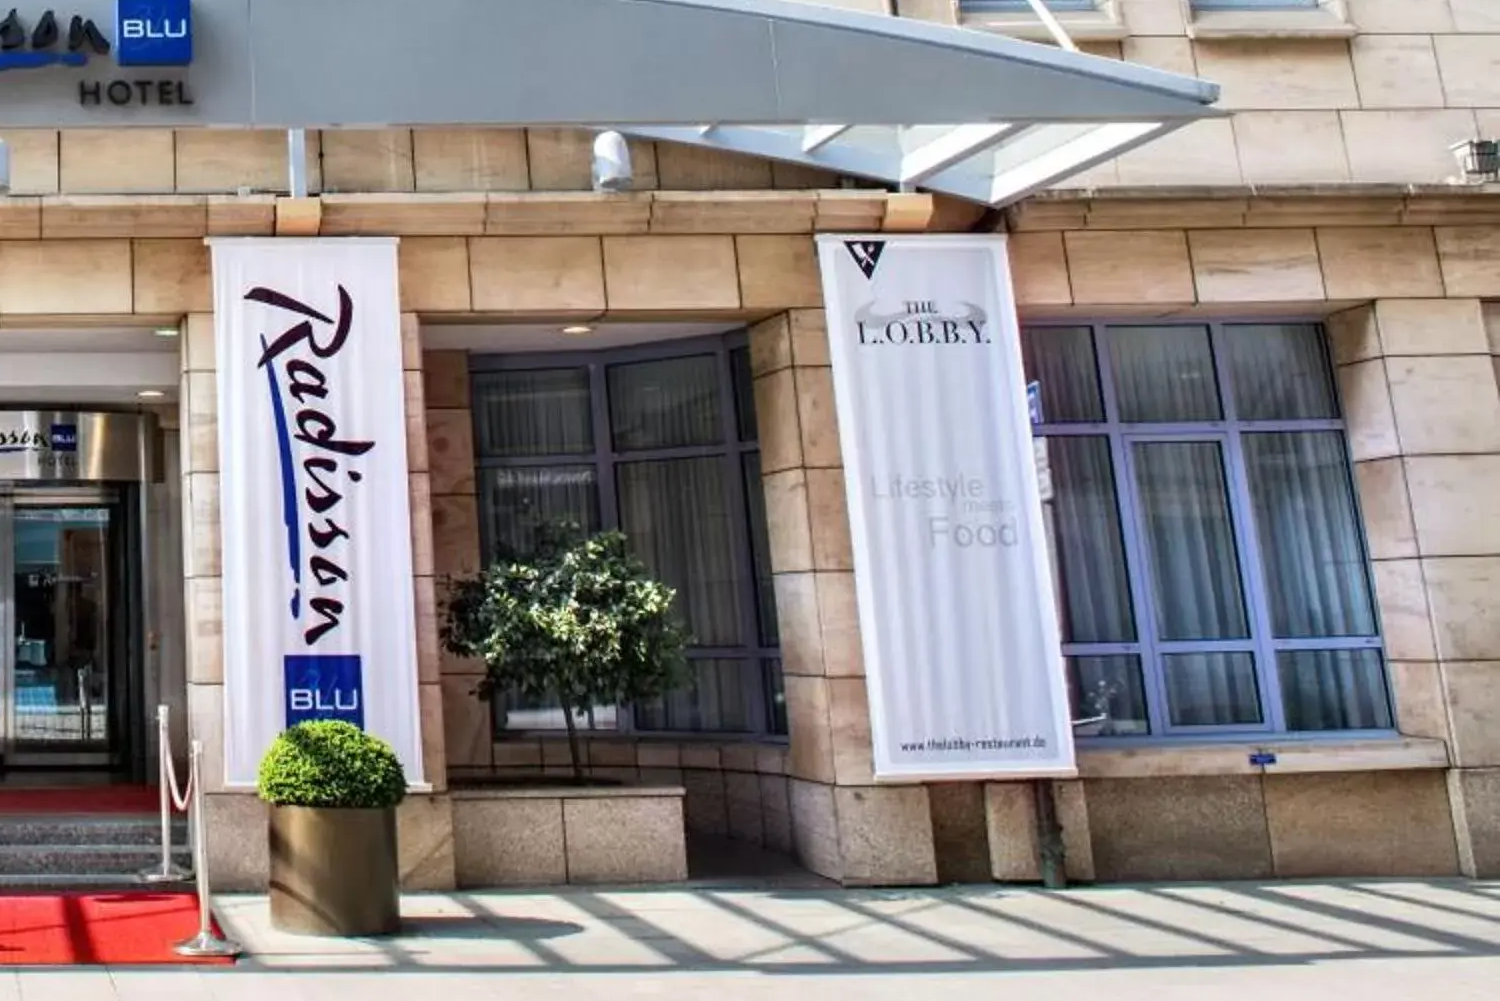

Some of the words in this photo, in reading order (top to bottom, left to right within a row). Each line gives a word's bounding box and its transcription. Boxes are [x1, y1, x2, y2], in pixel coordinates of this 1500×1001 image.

[122, 19, 187, 39] BLU
[79, 79, 195, 107] HOTEL
[904, 300, 939, 315] THE
[857, 319, 993, 345] L.O.B.B.Y.
[244, 284, 376, 646] Radisson
[871, 472, 984, 503] Lifestyle
[929, 516, 1019, 547] Food
[291, 689, 358, 710] BLU
